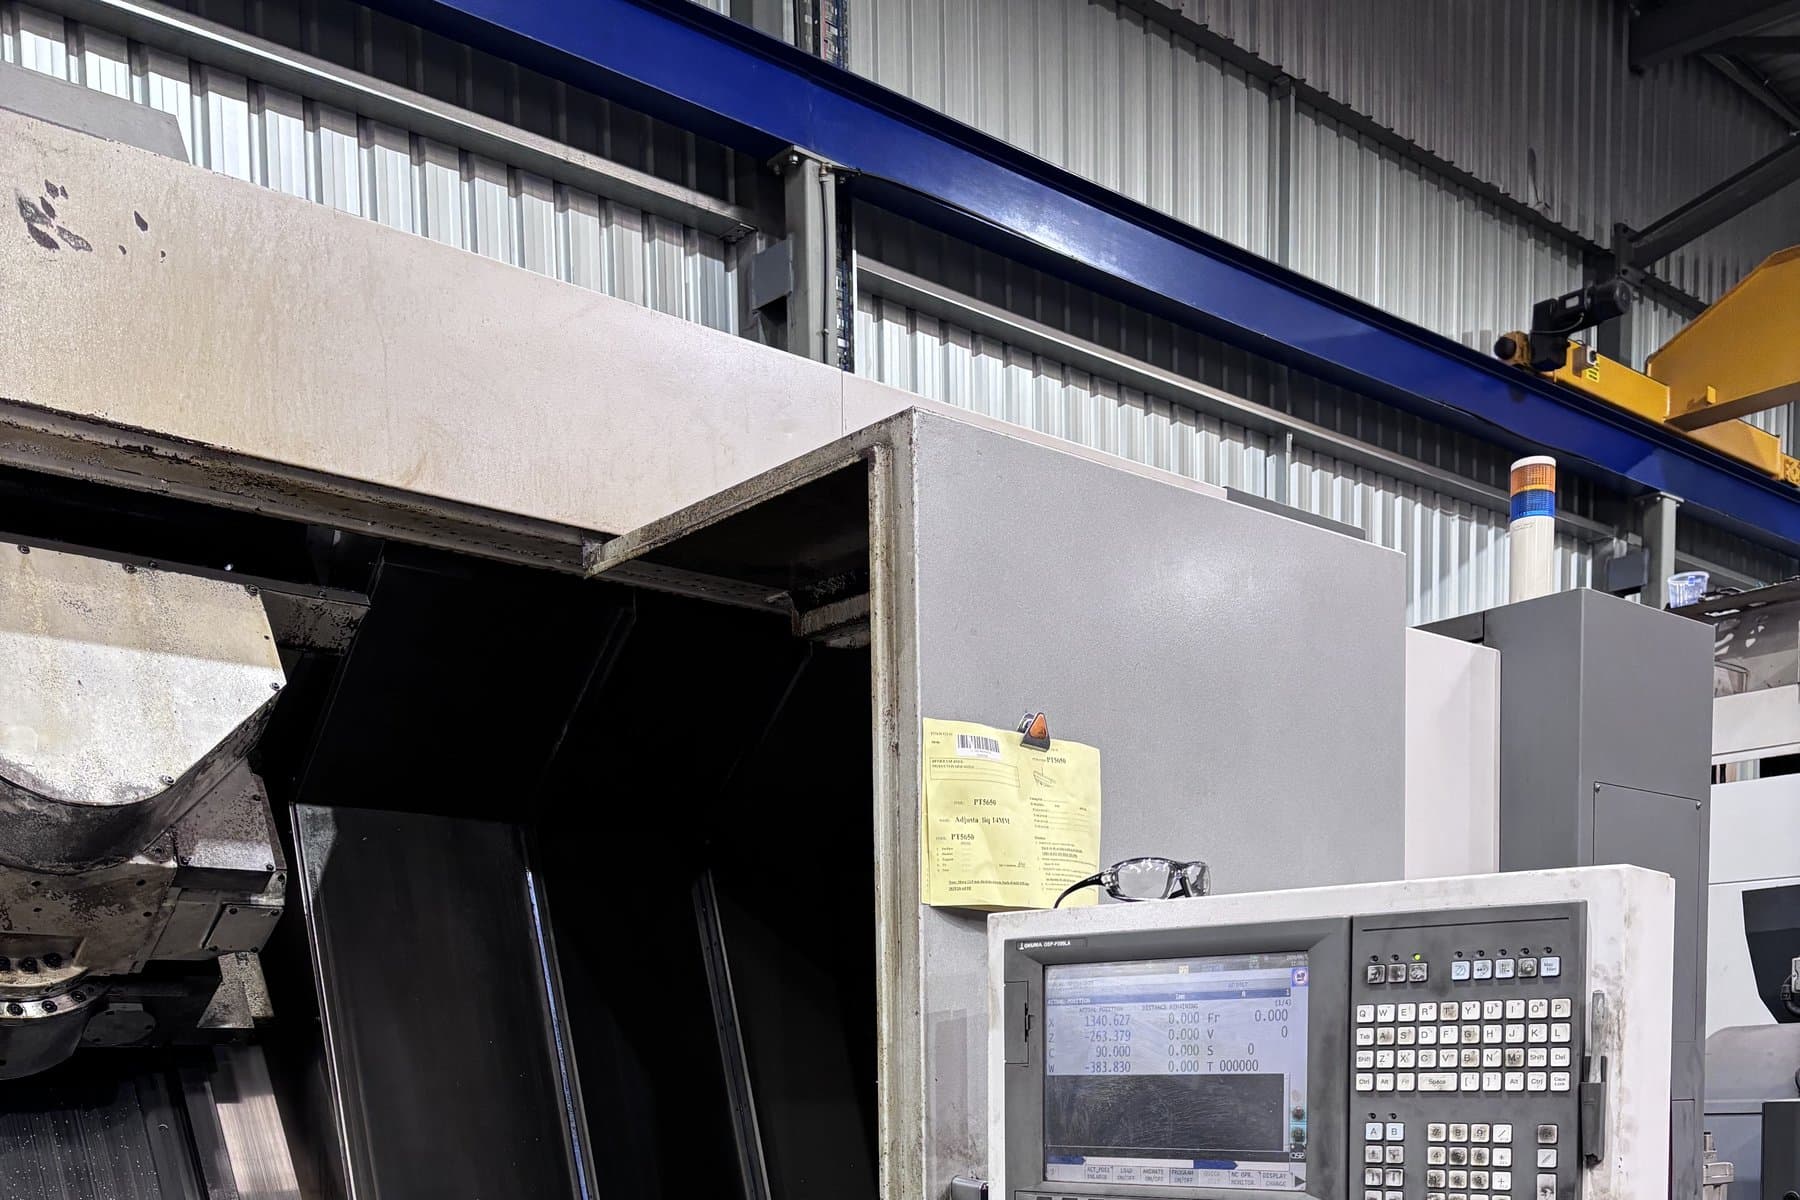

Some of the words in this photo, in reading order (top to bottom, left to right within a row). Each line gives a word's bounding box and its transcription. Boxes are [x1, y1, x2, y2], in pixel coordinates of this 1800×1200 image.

[973, 798, 997, 806] PT5650
[951, 833, 975, 841] PT5650
[1085, 1015, 1131, 1027] 1340.627
[1168, 1012, 1200, 1024] 0.000
[1255, 1009, 1288, 1022] 0.000
[1084, 1031, 1131, 1042] -263.379
[1168, 1028, 1200, 1040] 0.000
[1208, 1030, 1214, 1039] V
[1282, 1026, 1288, 1038] 0
[1096, 1046, 1131, 1058] 90.000
[1168, 1044, 1200, 1056] 0.000
[1208, 1046, 1214, 1056] S
[1248, 1043, 1254, 1055] 0
[1048, 1064, 1054, 1073] W
[1084, 1061, 1131, 1073] -383.830
[1168, 1060, 1200, 1072] 0.000
[1208, 1062, 1214, 1072] T
[1220, 1059, 1258, 1072] 000000
[1428, 1078, 1446, 1086] Space
